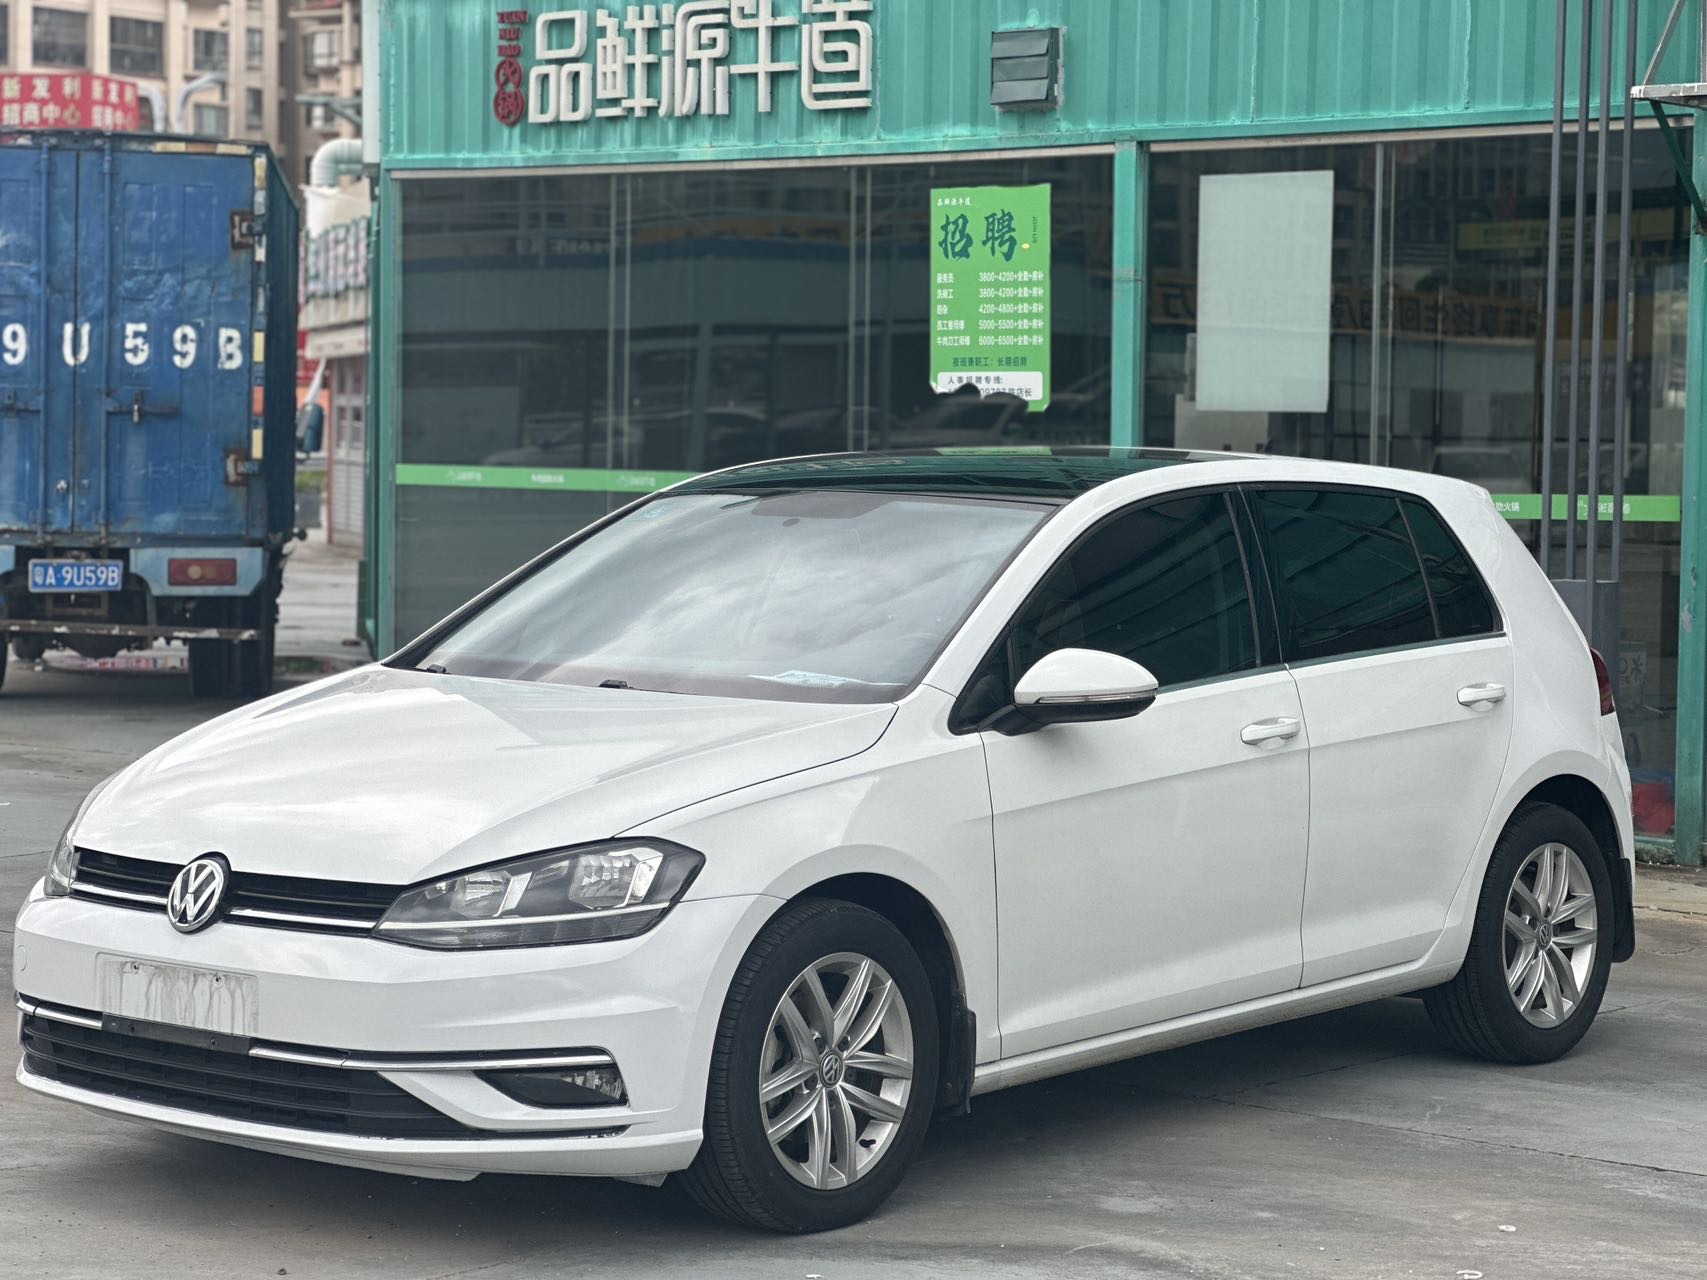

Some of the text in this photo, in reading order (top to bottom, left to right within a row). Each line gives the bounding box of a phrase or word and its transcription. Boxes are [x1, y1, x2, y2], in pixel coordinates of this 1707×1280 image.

[2, 102, 81, 127] 招商中心
[938, 209, 1018, 262] 招聘
